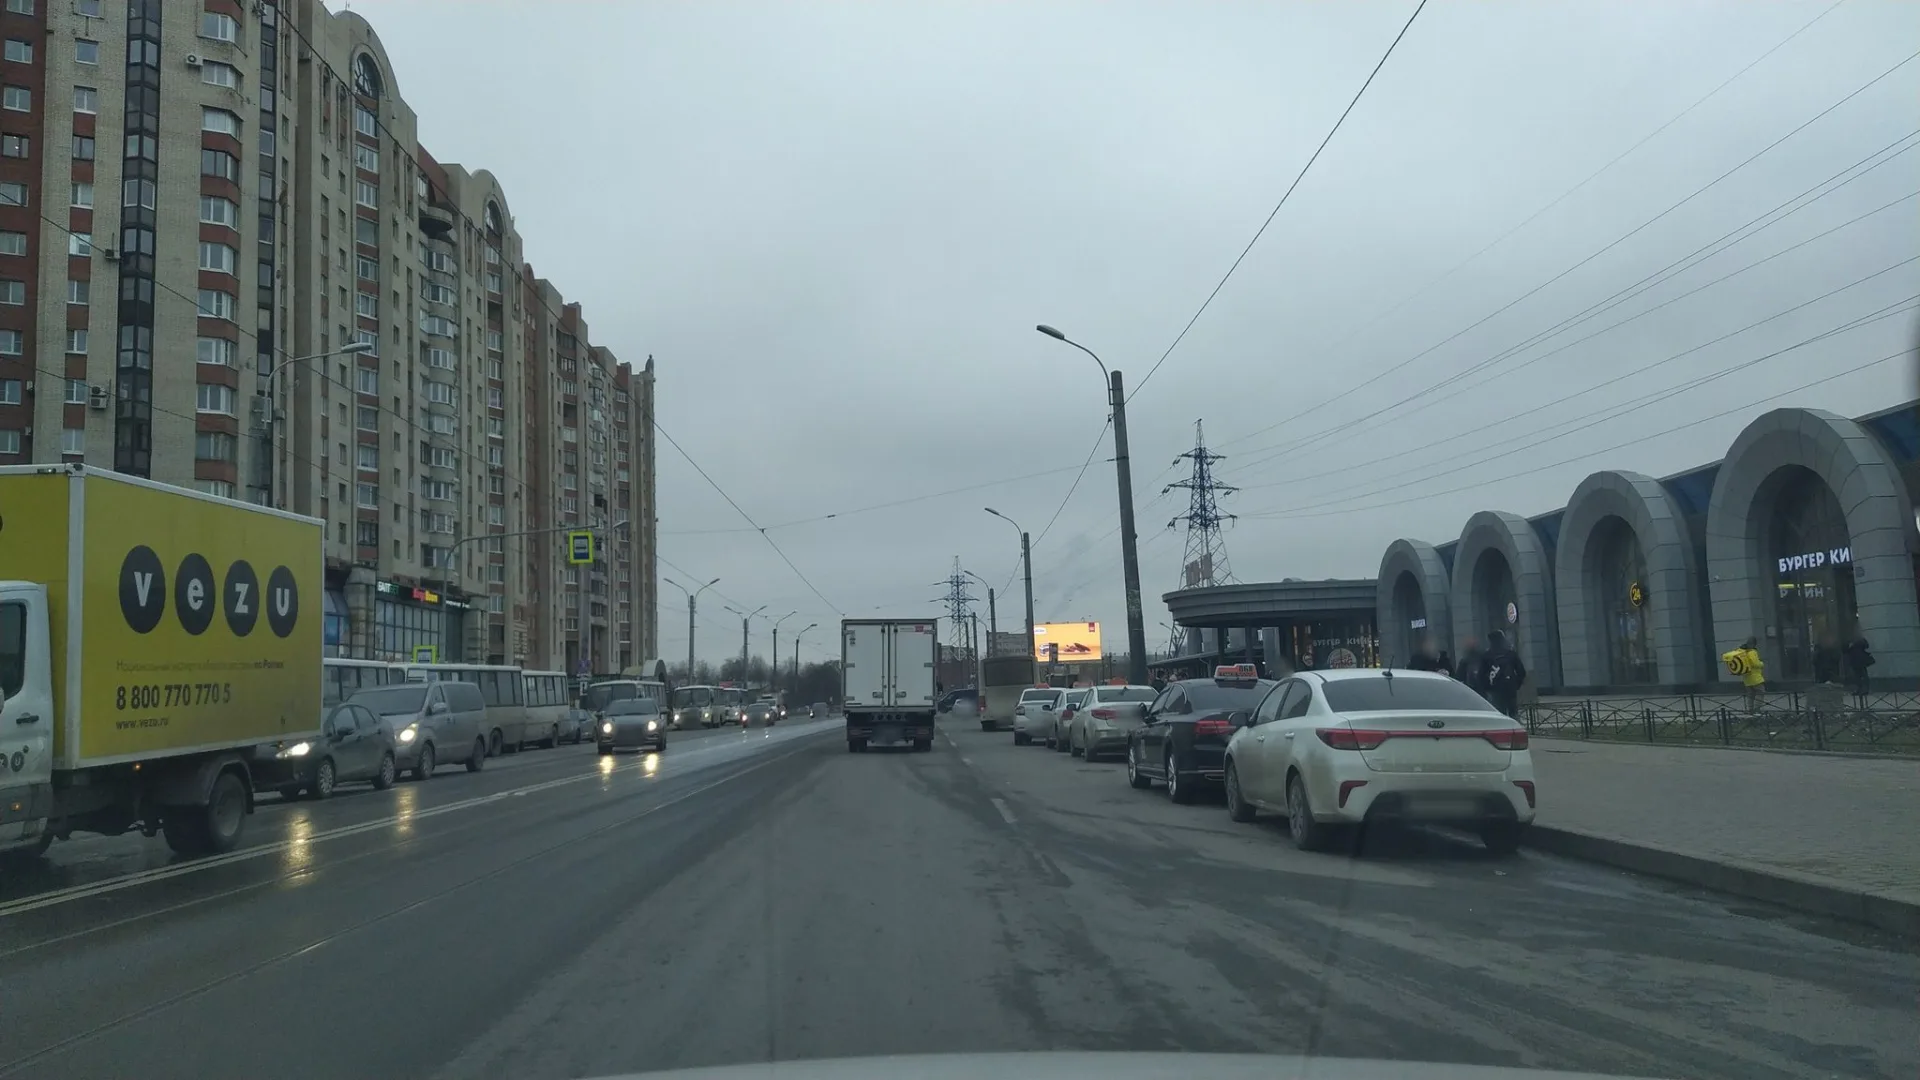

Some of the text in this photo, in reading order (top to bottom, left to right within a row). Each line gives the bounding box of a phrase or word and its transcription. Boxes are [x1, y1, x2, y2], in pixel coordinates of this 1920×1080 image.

[1778, 547, 1853, 573] БУРГЕР КИ
[134, 571, 290, 617] vezu
[115, 682, 231, 710] 8 800 770 770 5
